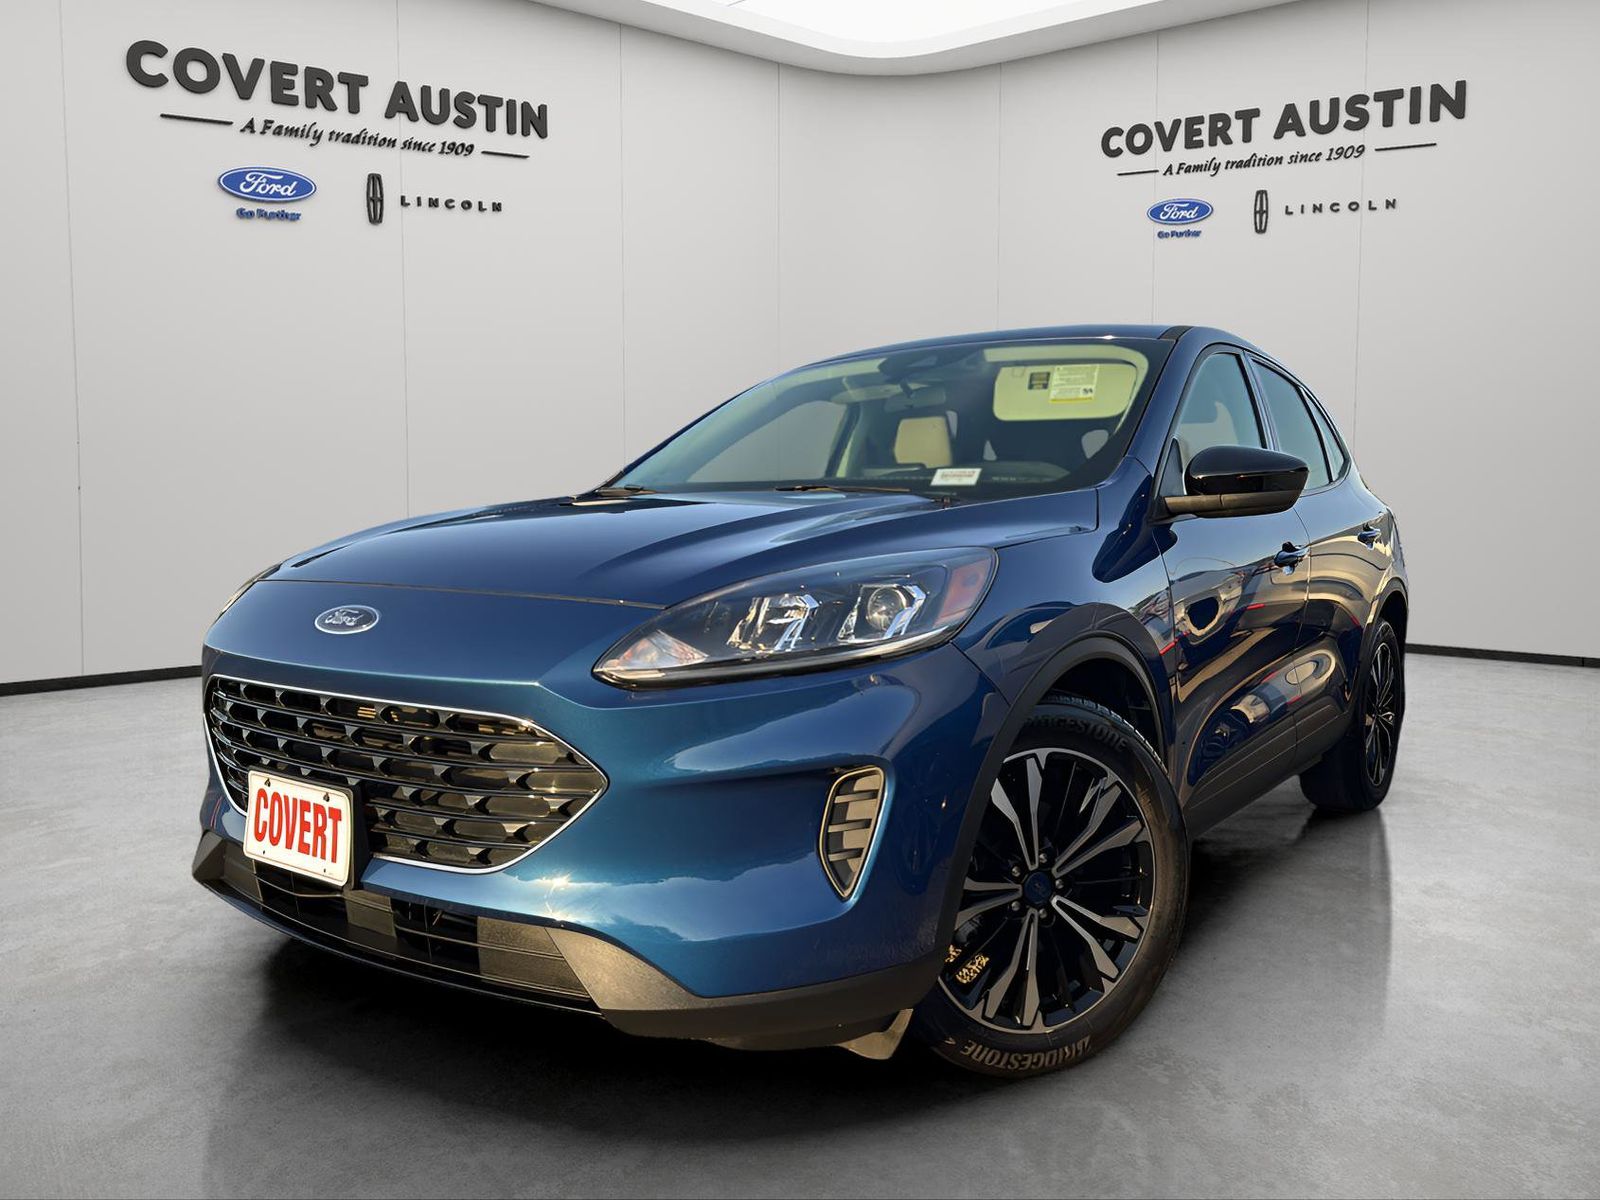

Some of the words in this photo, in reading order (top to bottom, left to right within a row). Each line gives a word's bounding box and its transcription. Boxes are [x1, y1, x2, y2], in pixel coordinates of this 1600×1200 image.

[126, 40, 368, 114] COVERT
[385, 80, 548, 139] AUSTIN
[1101, 108, 1261, 158] COVERT
[1273, 80, 1467, 140] AUSTIN
[240, 118, 256, 134] A
[260, 119, 324, 146] Family
[328, 126, 397, 149] tradition
[401, 136, 436, 155] since
[439, 140, 475, 157] 1909
[1163, 163, 1174, 176] A
[1176, 155, 1221, 177] Family
[1224, 150, 1283, 169] tradition
[1287, 149, 1323, 164] since
[1325, 144, 1366, 161] 1909
[240, 172, 297, 196] Ford
[400, 194, 503, 213] LINCOLN
[1160, 203, 1199, 219] Ford
[1285, 198, 1397, 216] LINCOLN
[325, 608, 364, 626] Ford
[254, 788, 342, 863] COVERT
[960, 1035, 1091, 1071] BRIDGESTONE
